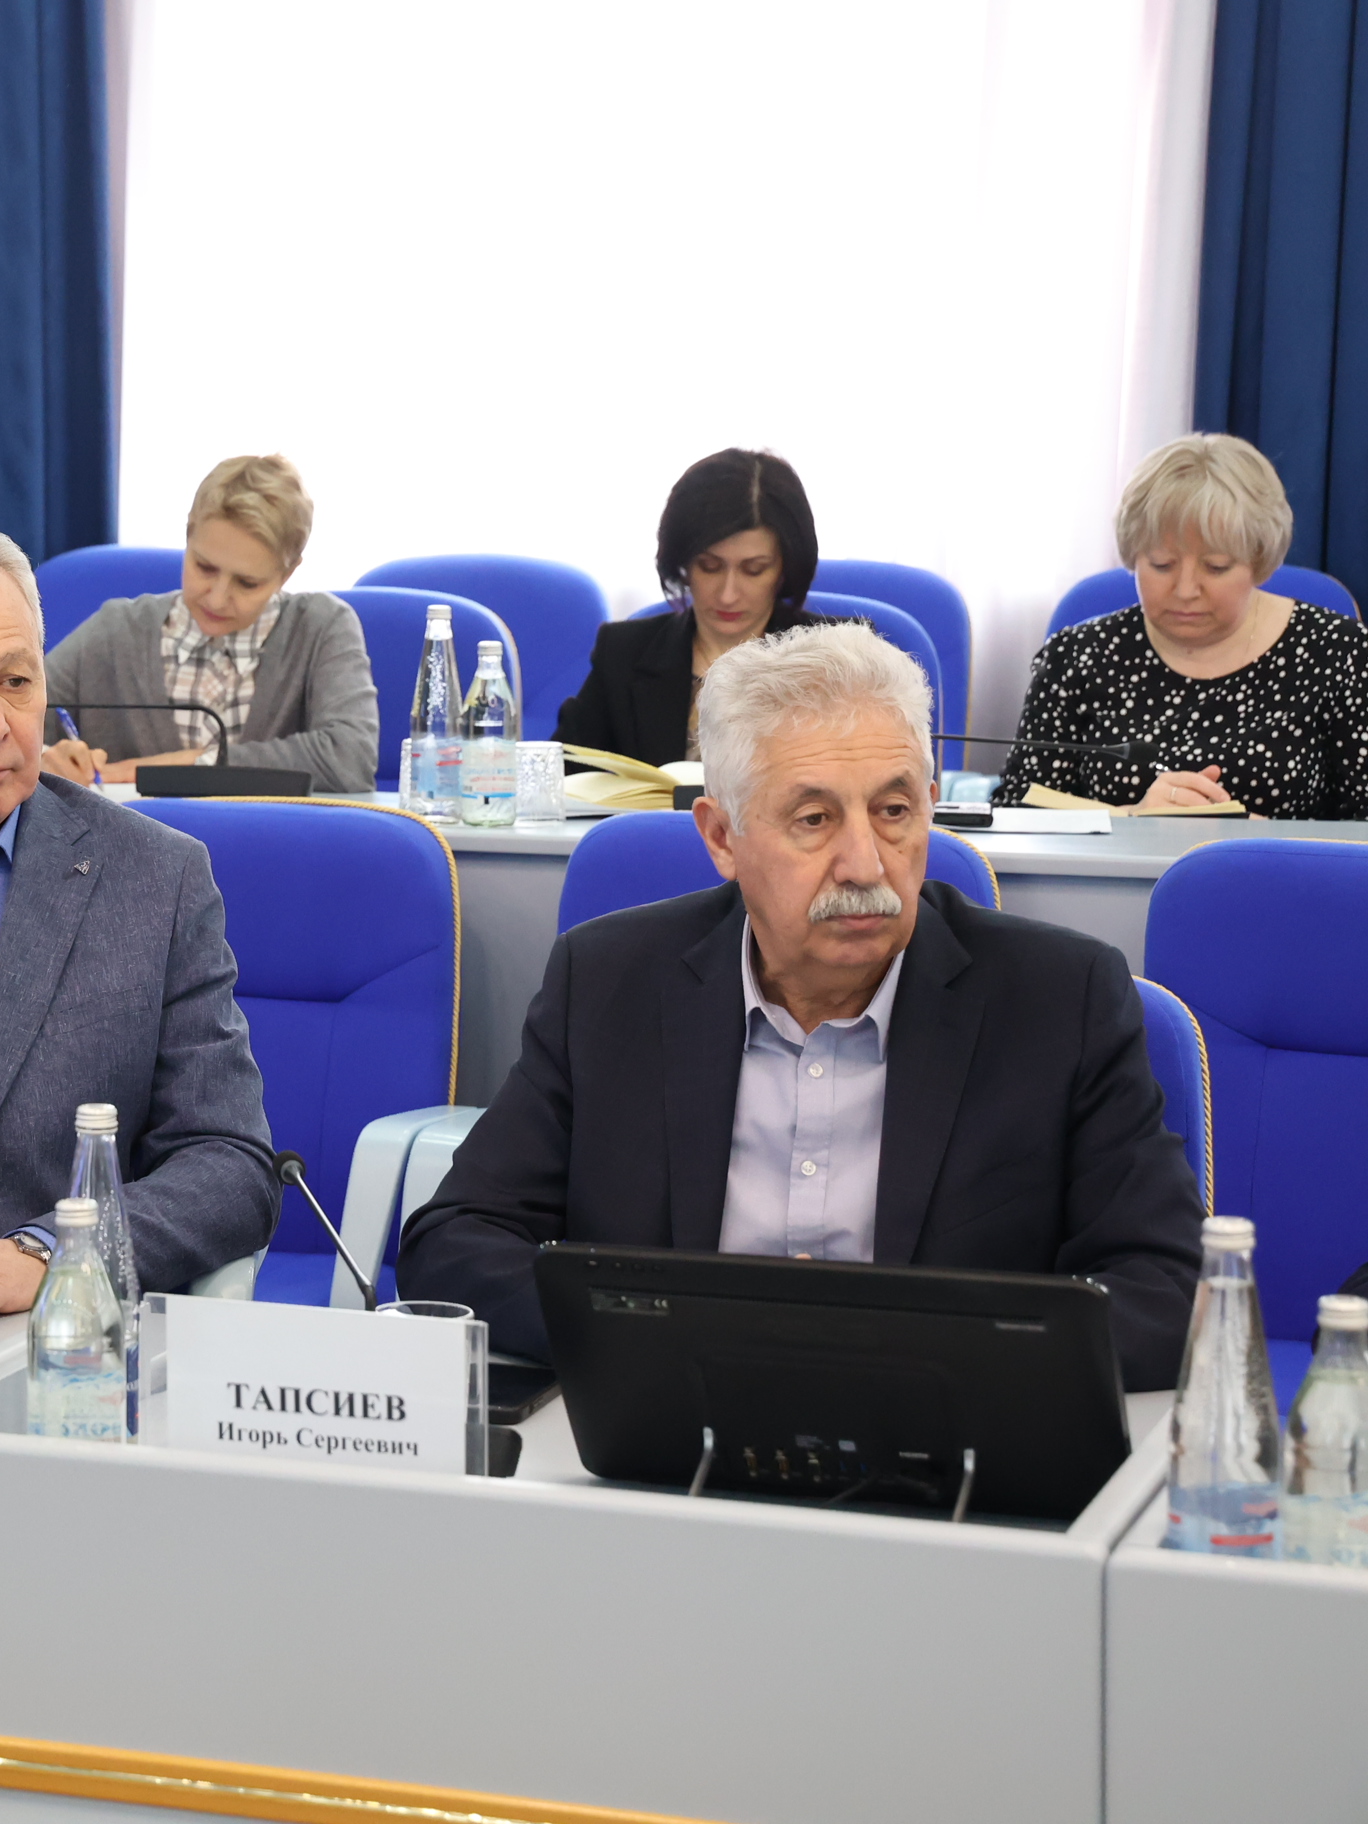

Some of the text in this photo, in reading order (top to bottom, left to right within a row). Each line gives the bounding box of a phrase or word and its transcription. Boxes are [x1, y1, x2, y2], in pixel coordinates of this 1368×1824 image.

[227, 1382, 407, 1422] ТАПСИЕВ
[217, 1422, 419, 1457] Игорь Сергеевич
